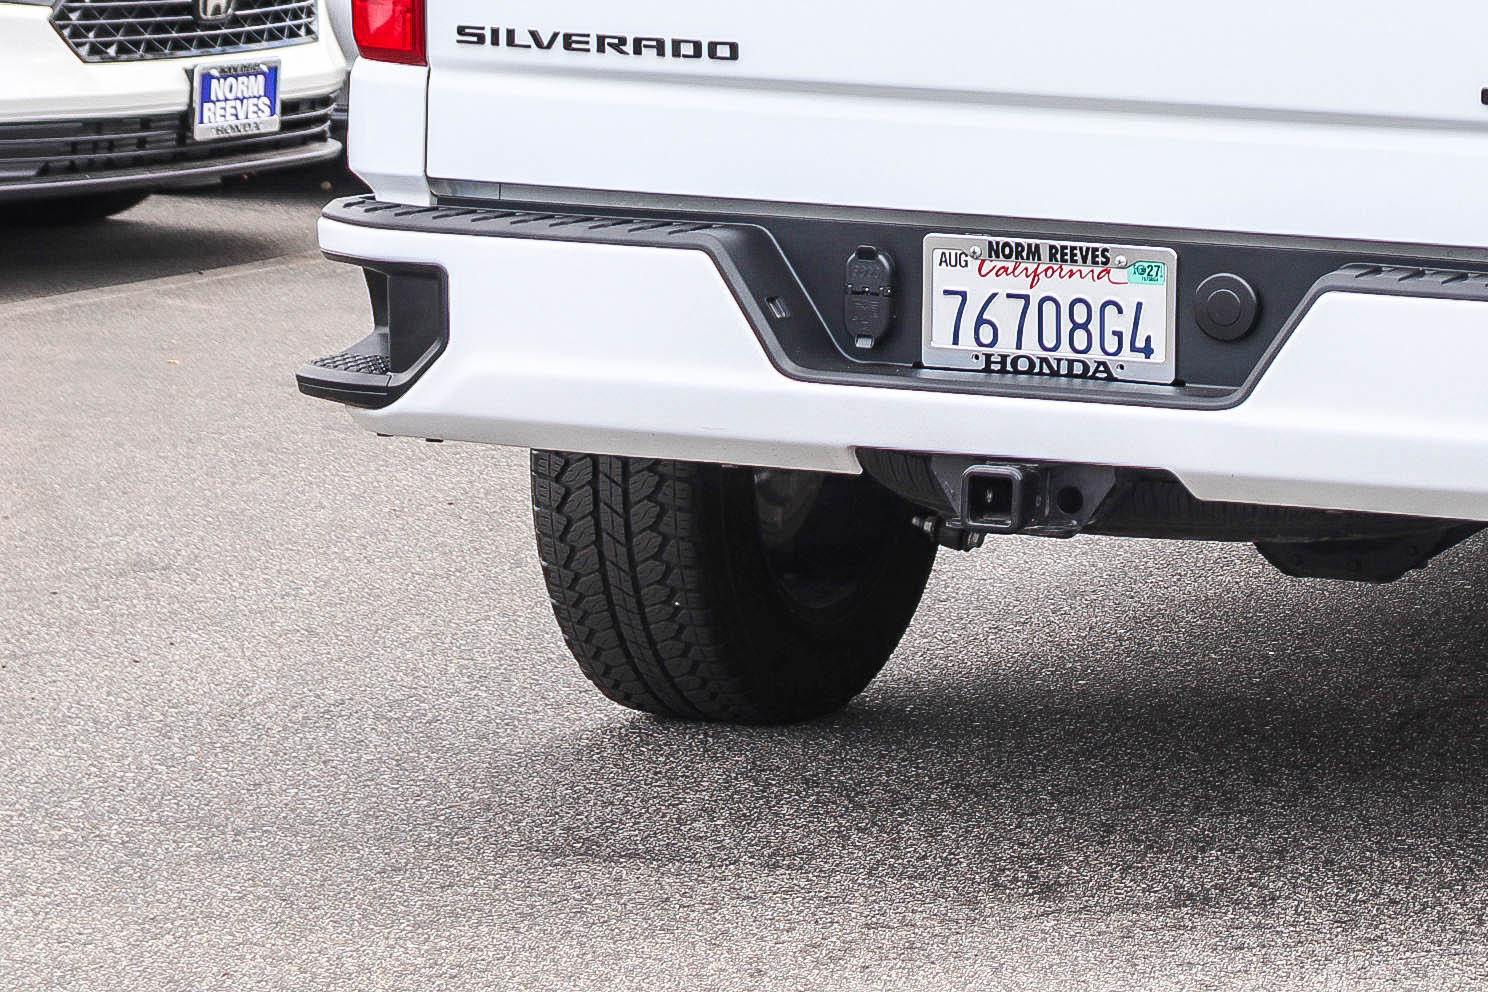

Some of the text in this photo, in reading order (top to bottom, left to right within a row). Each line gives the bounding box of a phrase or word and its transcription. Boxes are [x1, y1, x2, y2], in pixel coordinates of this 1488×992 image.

[456, 24, 740, 61] SILVERADO
[210, 74, 265, 101] NORM
[203, 96, 271, 123] REEVES
[938, 251, 969, 268] AUG
[987, 240, 1111, 266] NORM REEVES
[977, 259, 1128, 289] California
[1147, 264, 1160, 278] 27
[943, 289, 1155, 359] 76708G4
[981, 352, 1118, 380] HONDA
